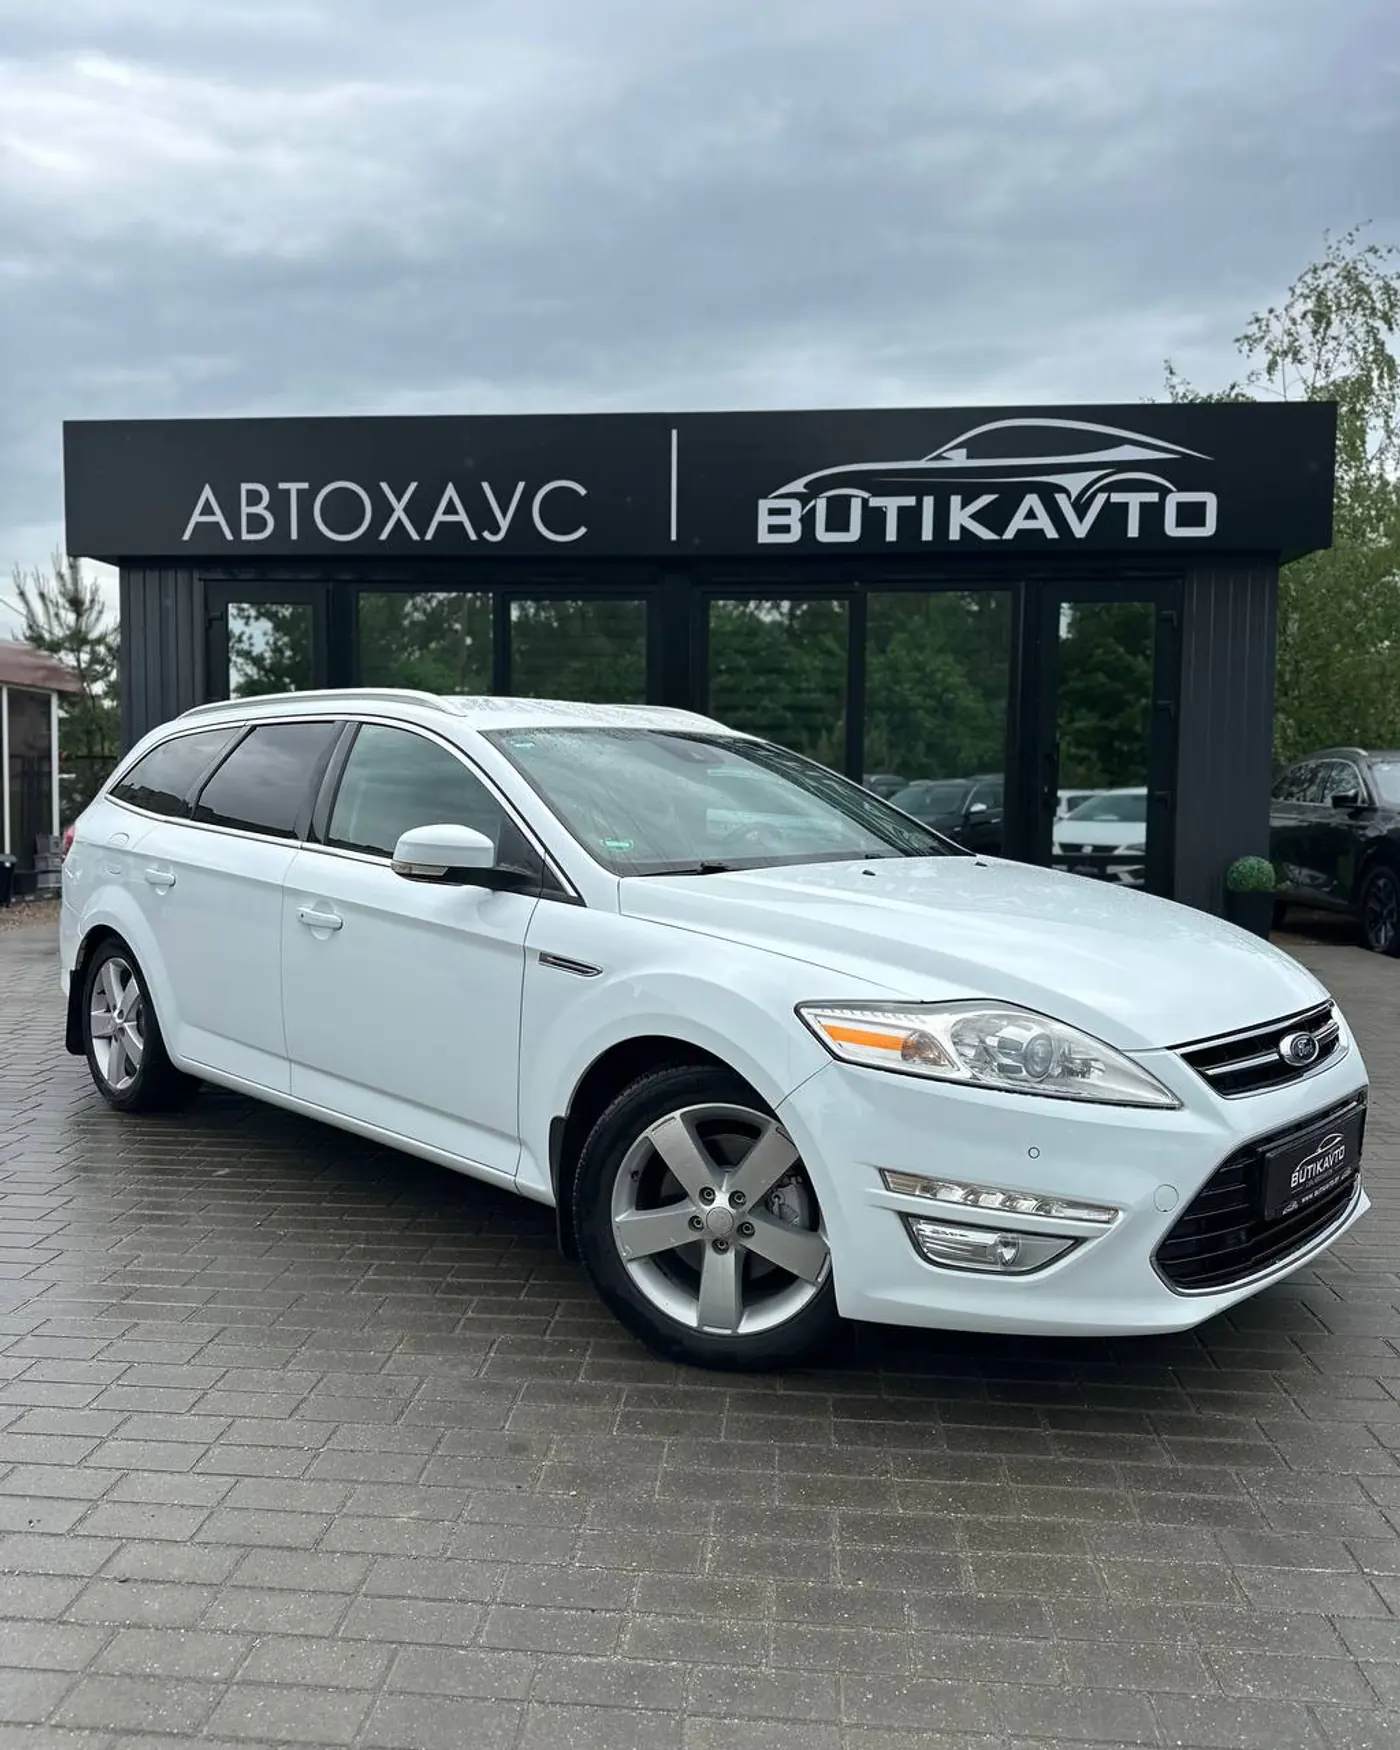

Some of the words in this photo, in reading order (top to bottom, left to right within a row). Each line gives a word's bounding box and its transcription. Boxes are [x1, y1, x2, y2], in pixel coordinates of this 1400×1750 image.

[182, 480, 589, 543] АВТОХАУС
[757, 491, 1218, 544] BUTIKAVTO
[1290, 1145, 1345, 1188] BUTIKAVTO
